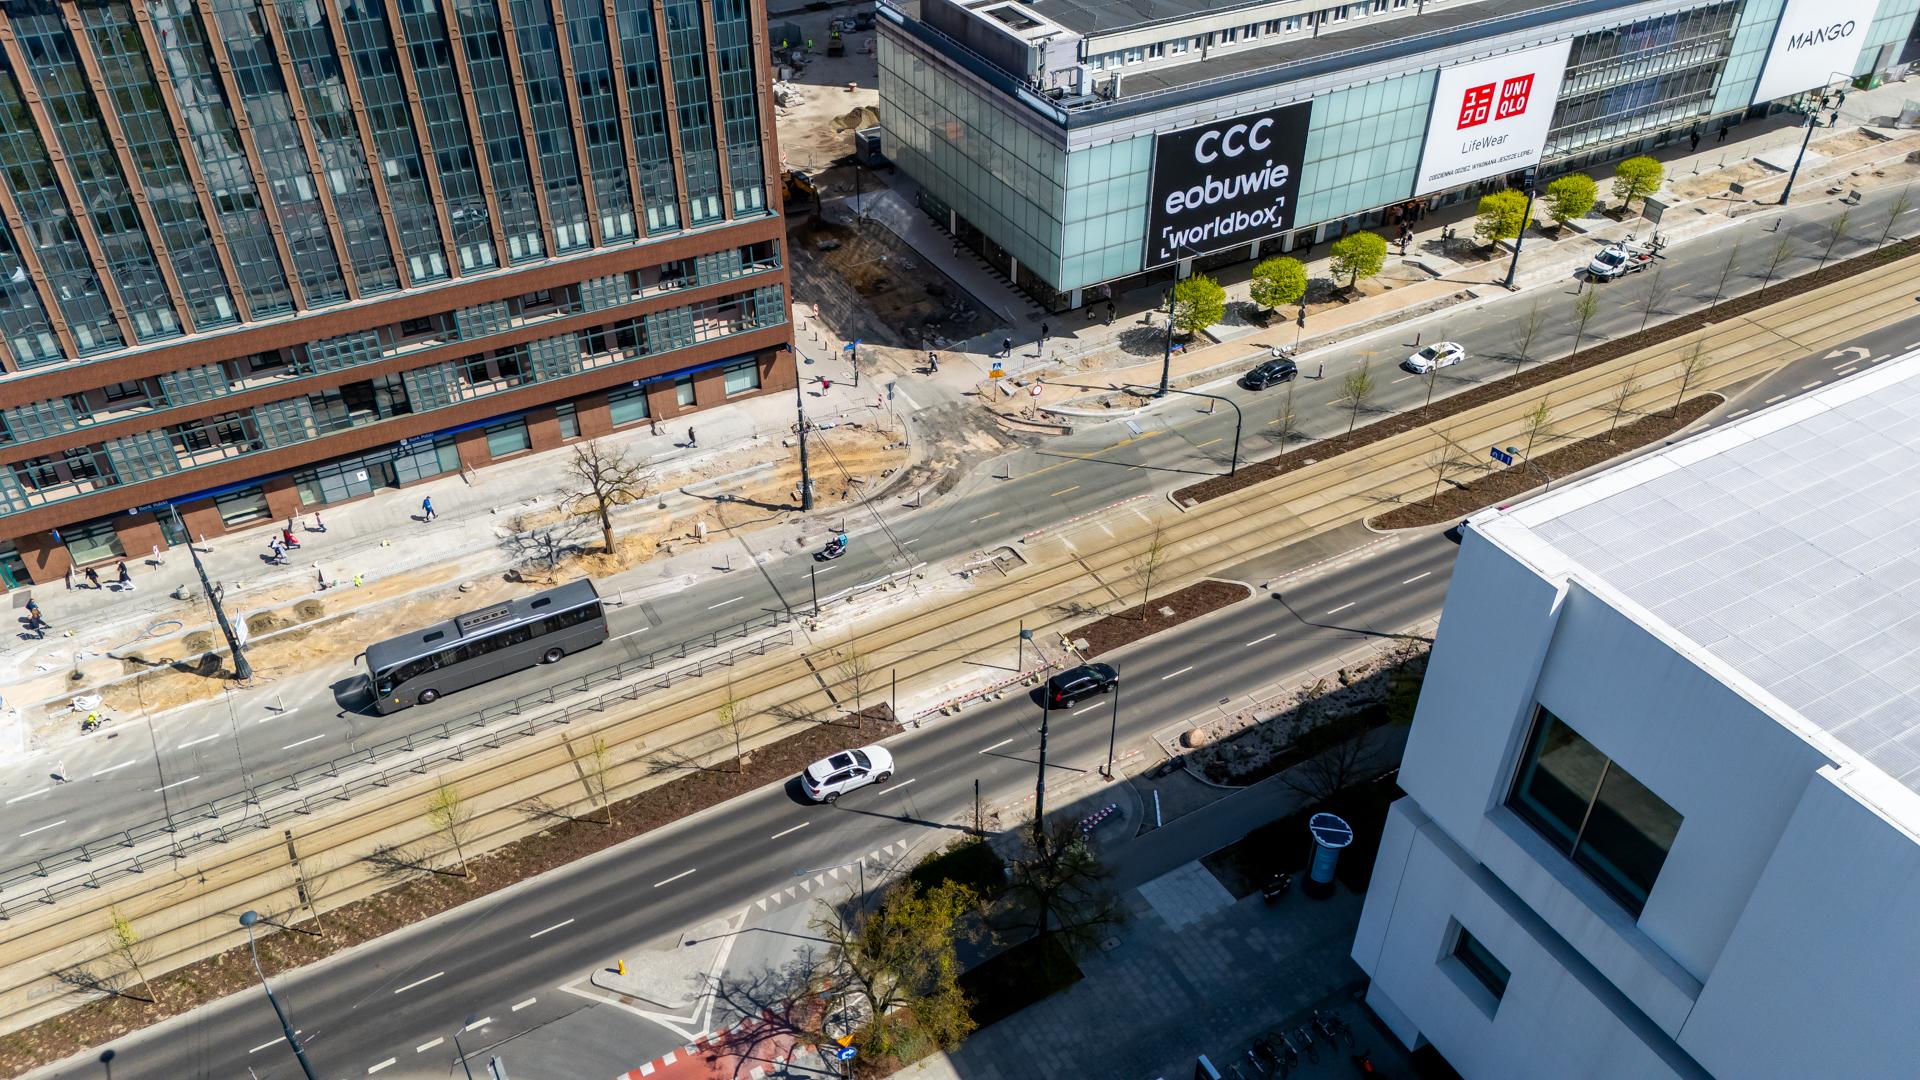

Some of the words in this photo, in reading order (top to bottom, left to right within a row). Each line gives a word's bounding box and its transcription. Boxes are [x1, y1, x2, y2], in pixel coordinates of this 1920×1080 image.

[1787, 20, 1855, 52] MANGO
[1504, 79, 1528, 98] UNI
[1500, 96, 1525, 117] QLO
[1194, 117, 1274, 164] CCC
[1461, 134, 1509, 155] LifeWear
[1165, 159, 1289, 215] eobuwie
